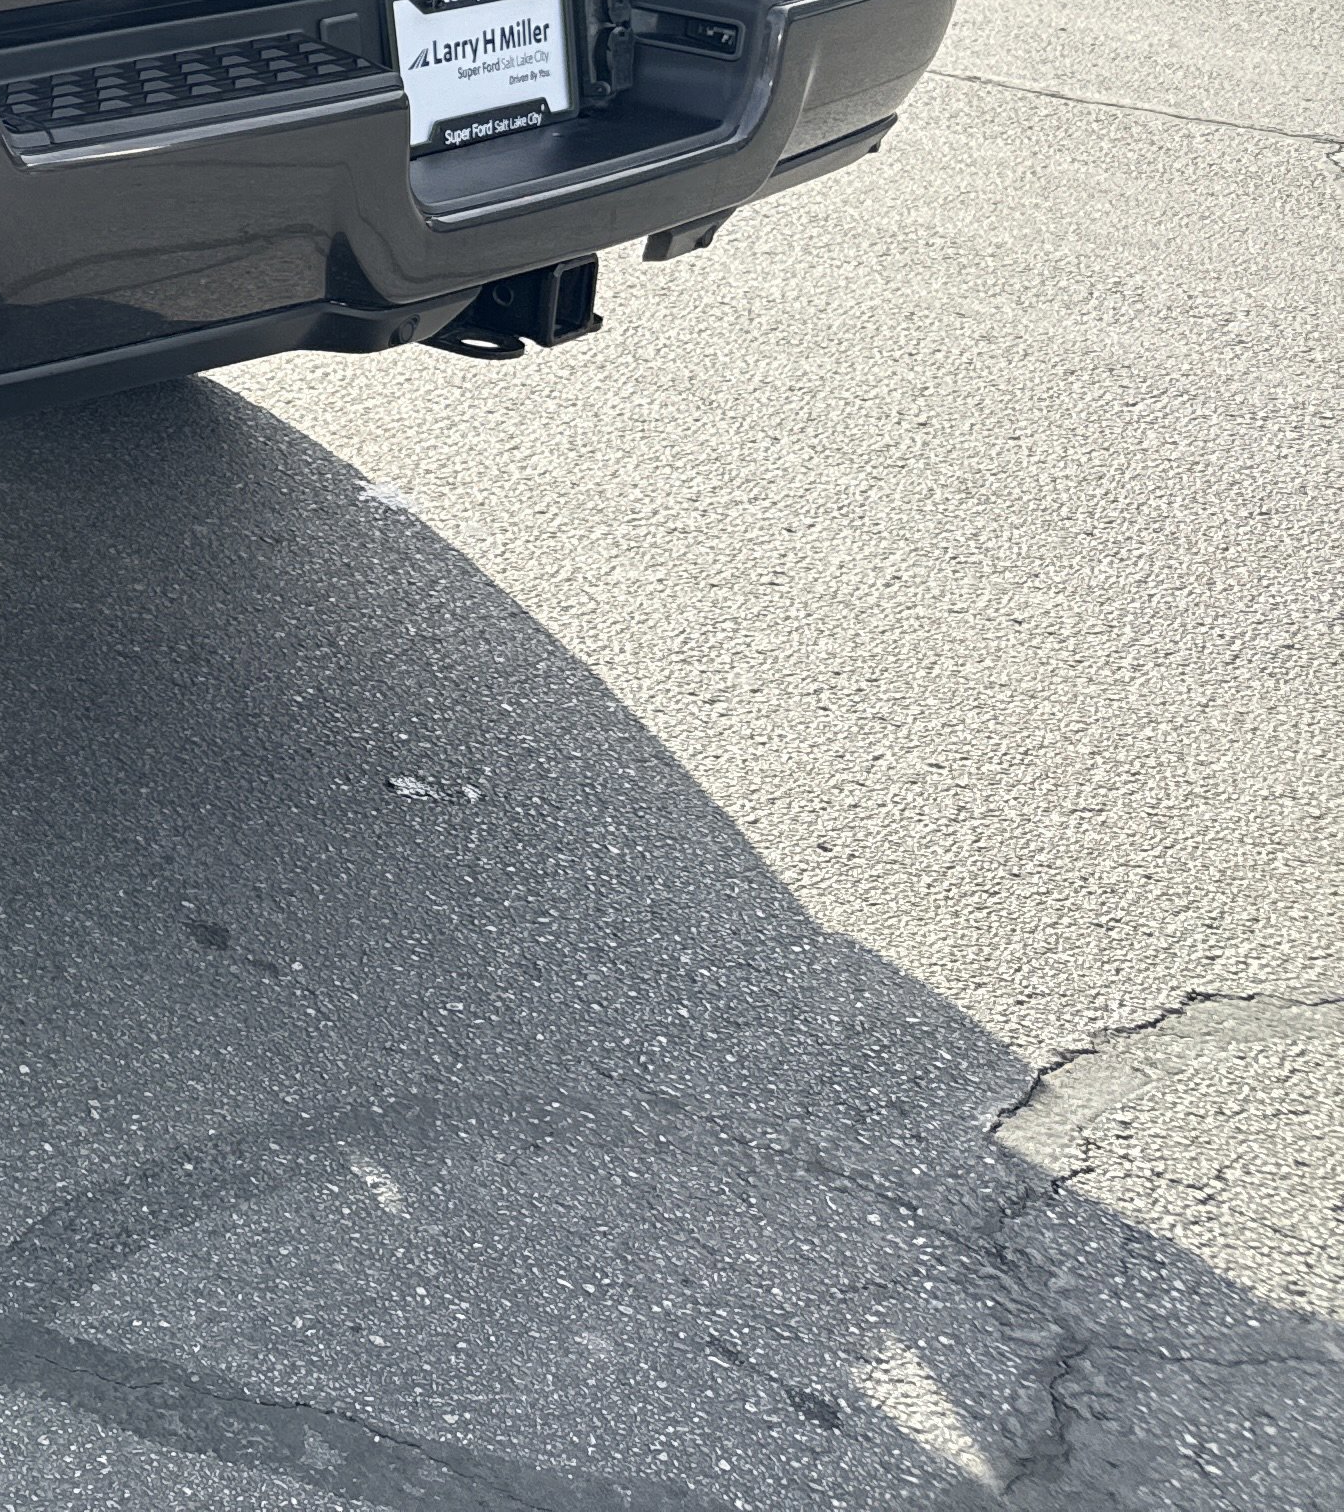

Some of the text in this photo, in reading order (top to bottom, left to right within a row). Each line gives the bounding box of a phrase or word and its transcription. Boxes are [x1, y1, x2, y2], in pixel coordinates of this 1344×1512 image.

[431, 18, 550, 65] Larry H Miller
[457, 49, 550, 81] Super Ford Salt Lake City
[508, 73, 529, 85] Driven
[530, 70, 538, 82] By
[444, 112, 542, 146] Super Ford Salt Lake City
